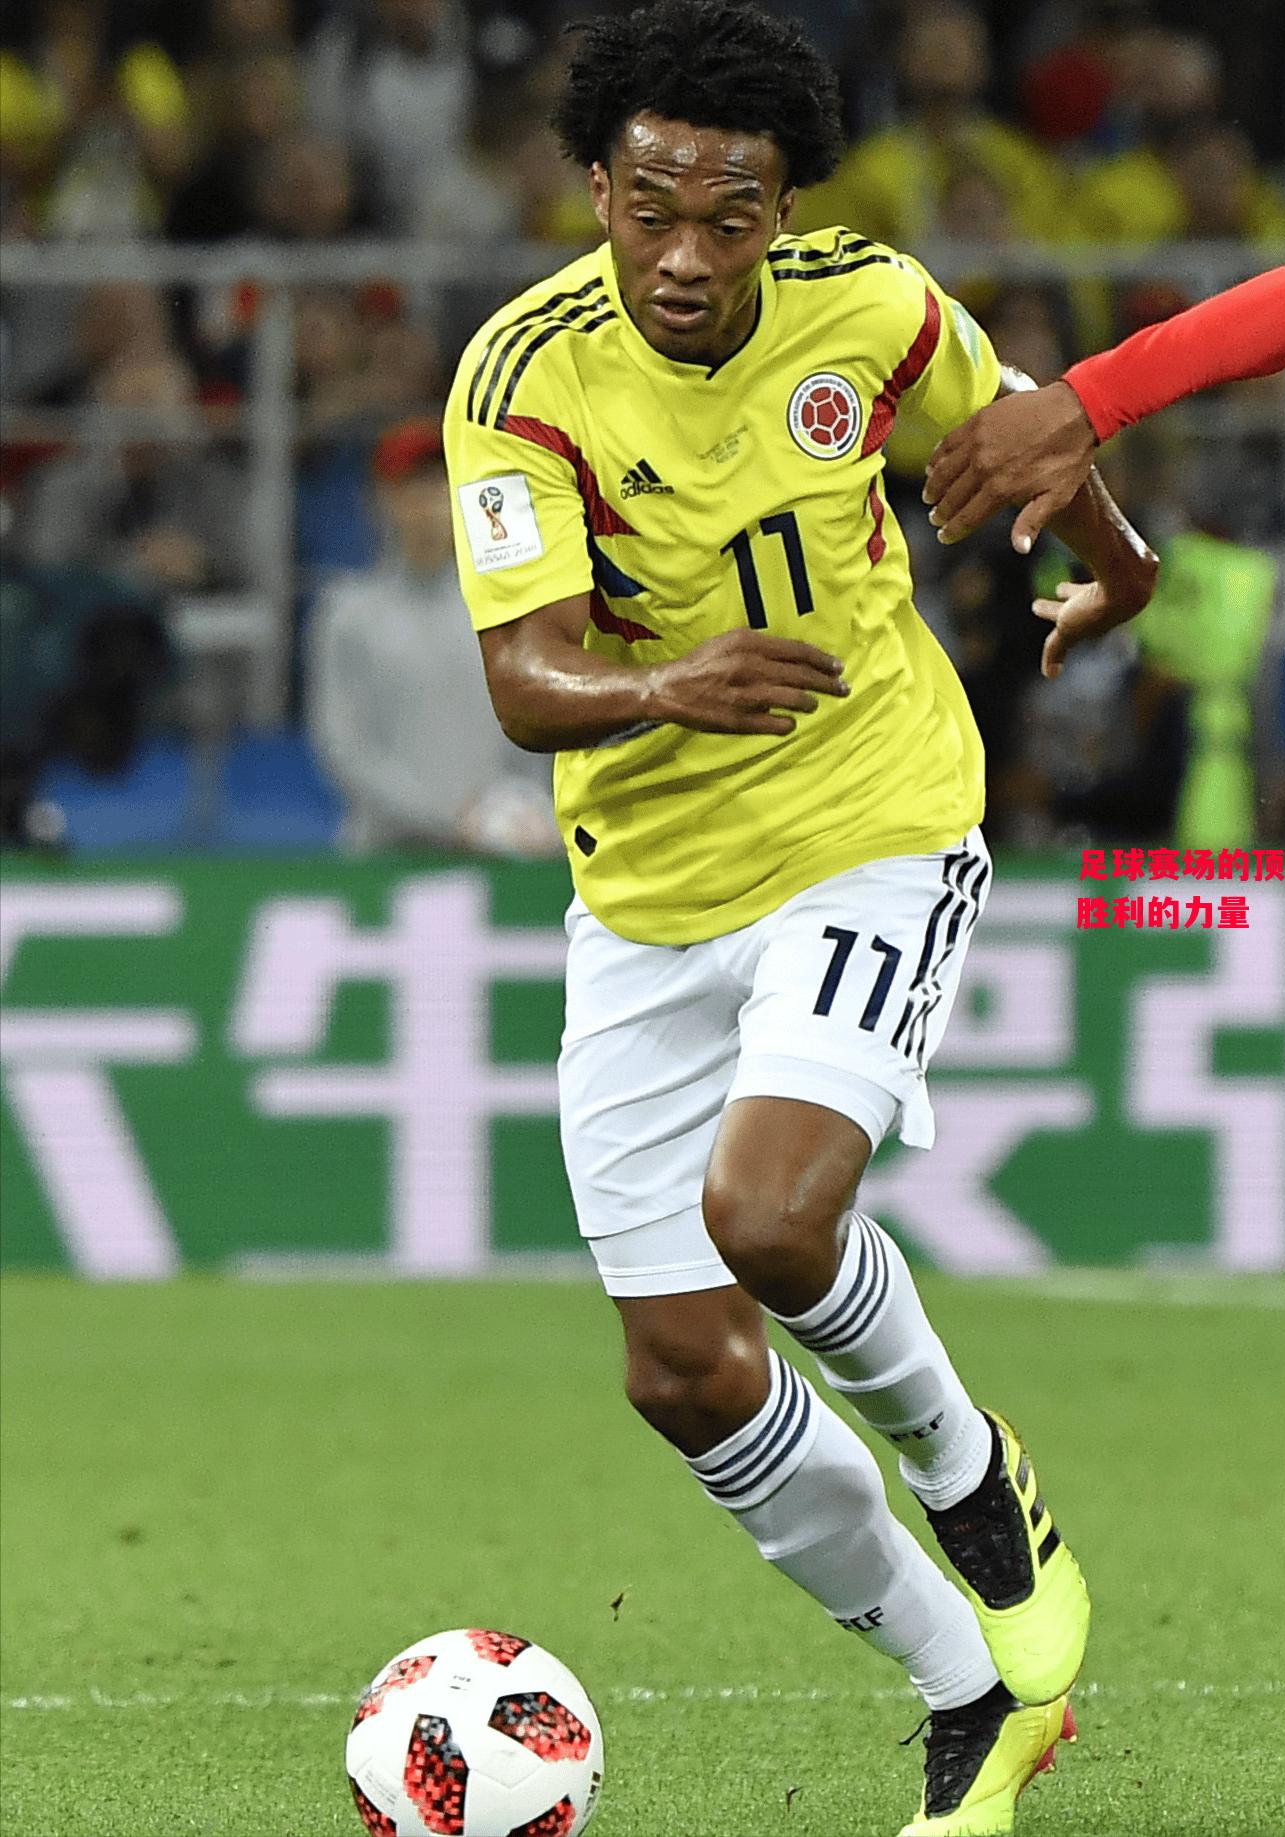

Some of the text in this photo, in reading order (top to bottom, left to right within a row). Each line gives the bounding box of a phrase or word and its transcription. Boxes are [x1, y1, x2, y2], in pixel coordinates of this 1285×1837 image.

[621, 480, 675, 500] adidas
[720, 510, 815, 630] 11
[812, 924, 903, 1033] 11
